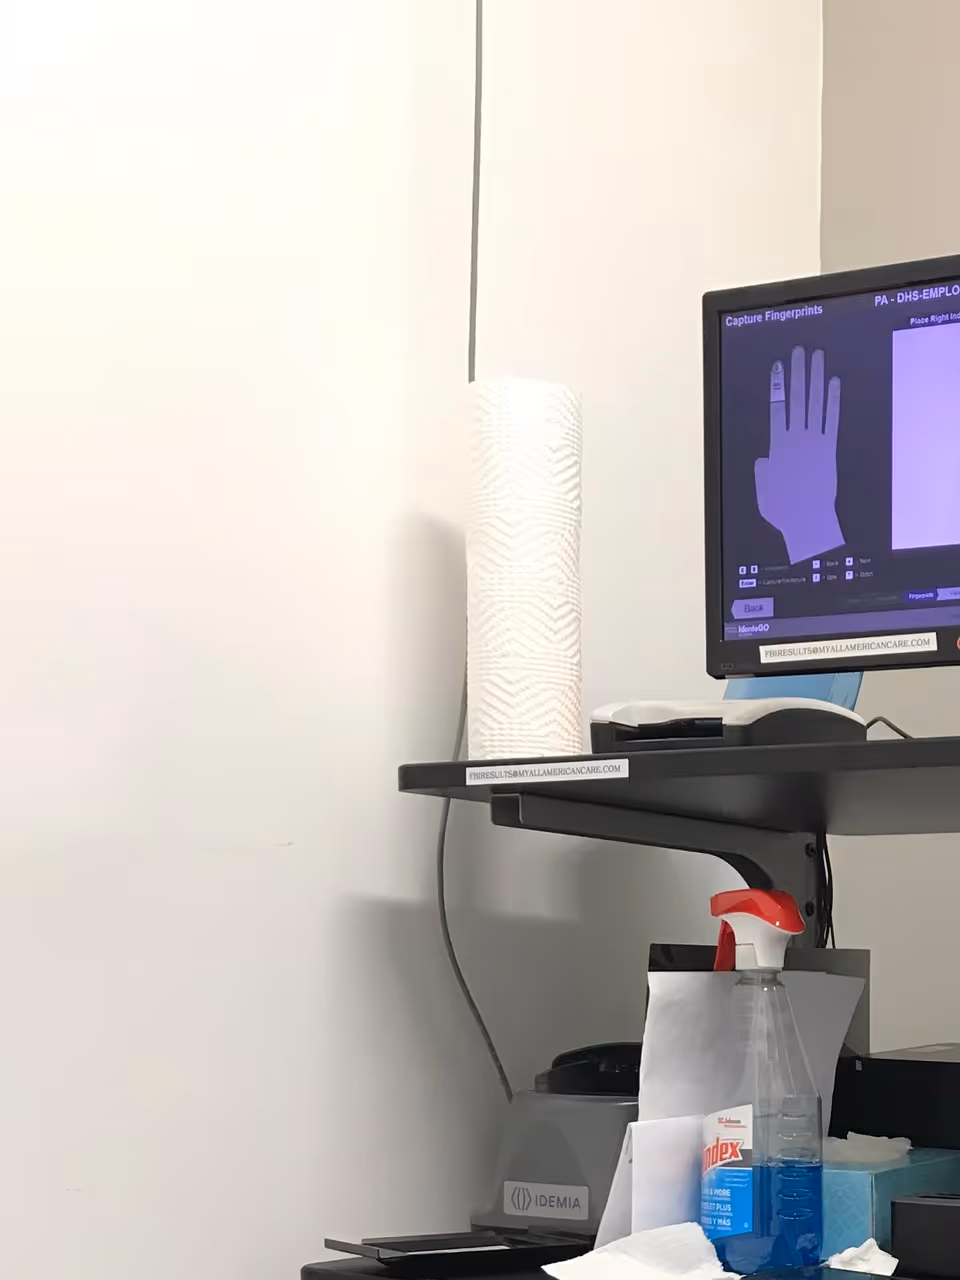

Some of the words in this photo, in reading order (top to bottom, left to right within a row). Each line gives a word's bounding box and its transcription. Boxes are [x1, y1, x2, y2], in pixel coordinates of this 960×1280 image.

[874, 295, 888, 307] PA
[725, 313, 762, 327] Capture
[765, 304, 823, 322] Fingerprints
[910, 314, 929, 326] Place
[930, 313, 949, 323] Right
[703, 1137, 741, 1170] ndex
[535, 1194, 581, 1209] IDEMIA
